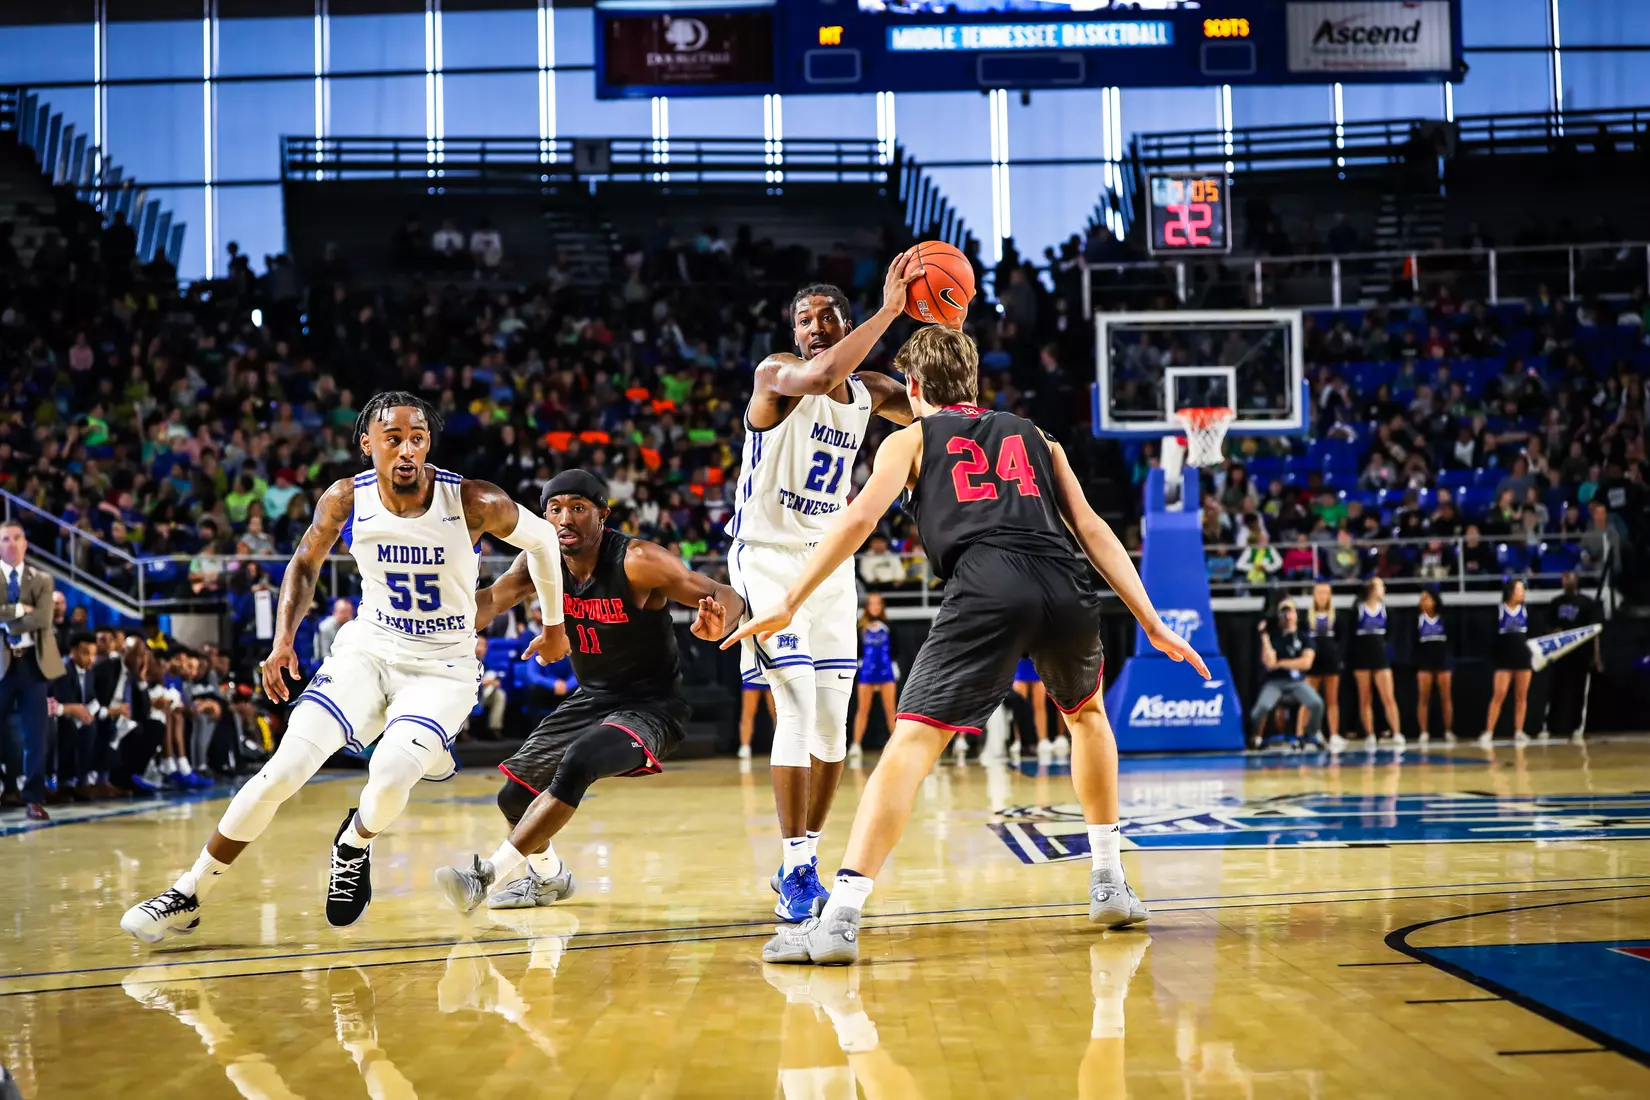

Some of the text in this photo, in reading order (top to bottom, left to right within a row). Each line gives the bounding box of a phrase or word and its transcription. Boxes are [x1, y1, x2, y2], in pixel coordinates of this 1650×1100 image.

[892, 22, 1168, 49] MIDDLE TENNESSEE BASKETBALL
[1204, 18, 1249, 38] SCOTS
[1312, 18, 1421, 46] Ascend
[1164, 203, 1212, 246] 22
[804, 450, 845, 495] 21
[946, 434, 1041, 503] 24
[780, 487, 841, 516] TENNESS
[377, 544, 445, 565] MIDDLE
[385, 571, 442, 612] 55
[576, 624, 602, 653] 11
[1129, 694, 1223, 719] Ascend
